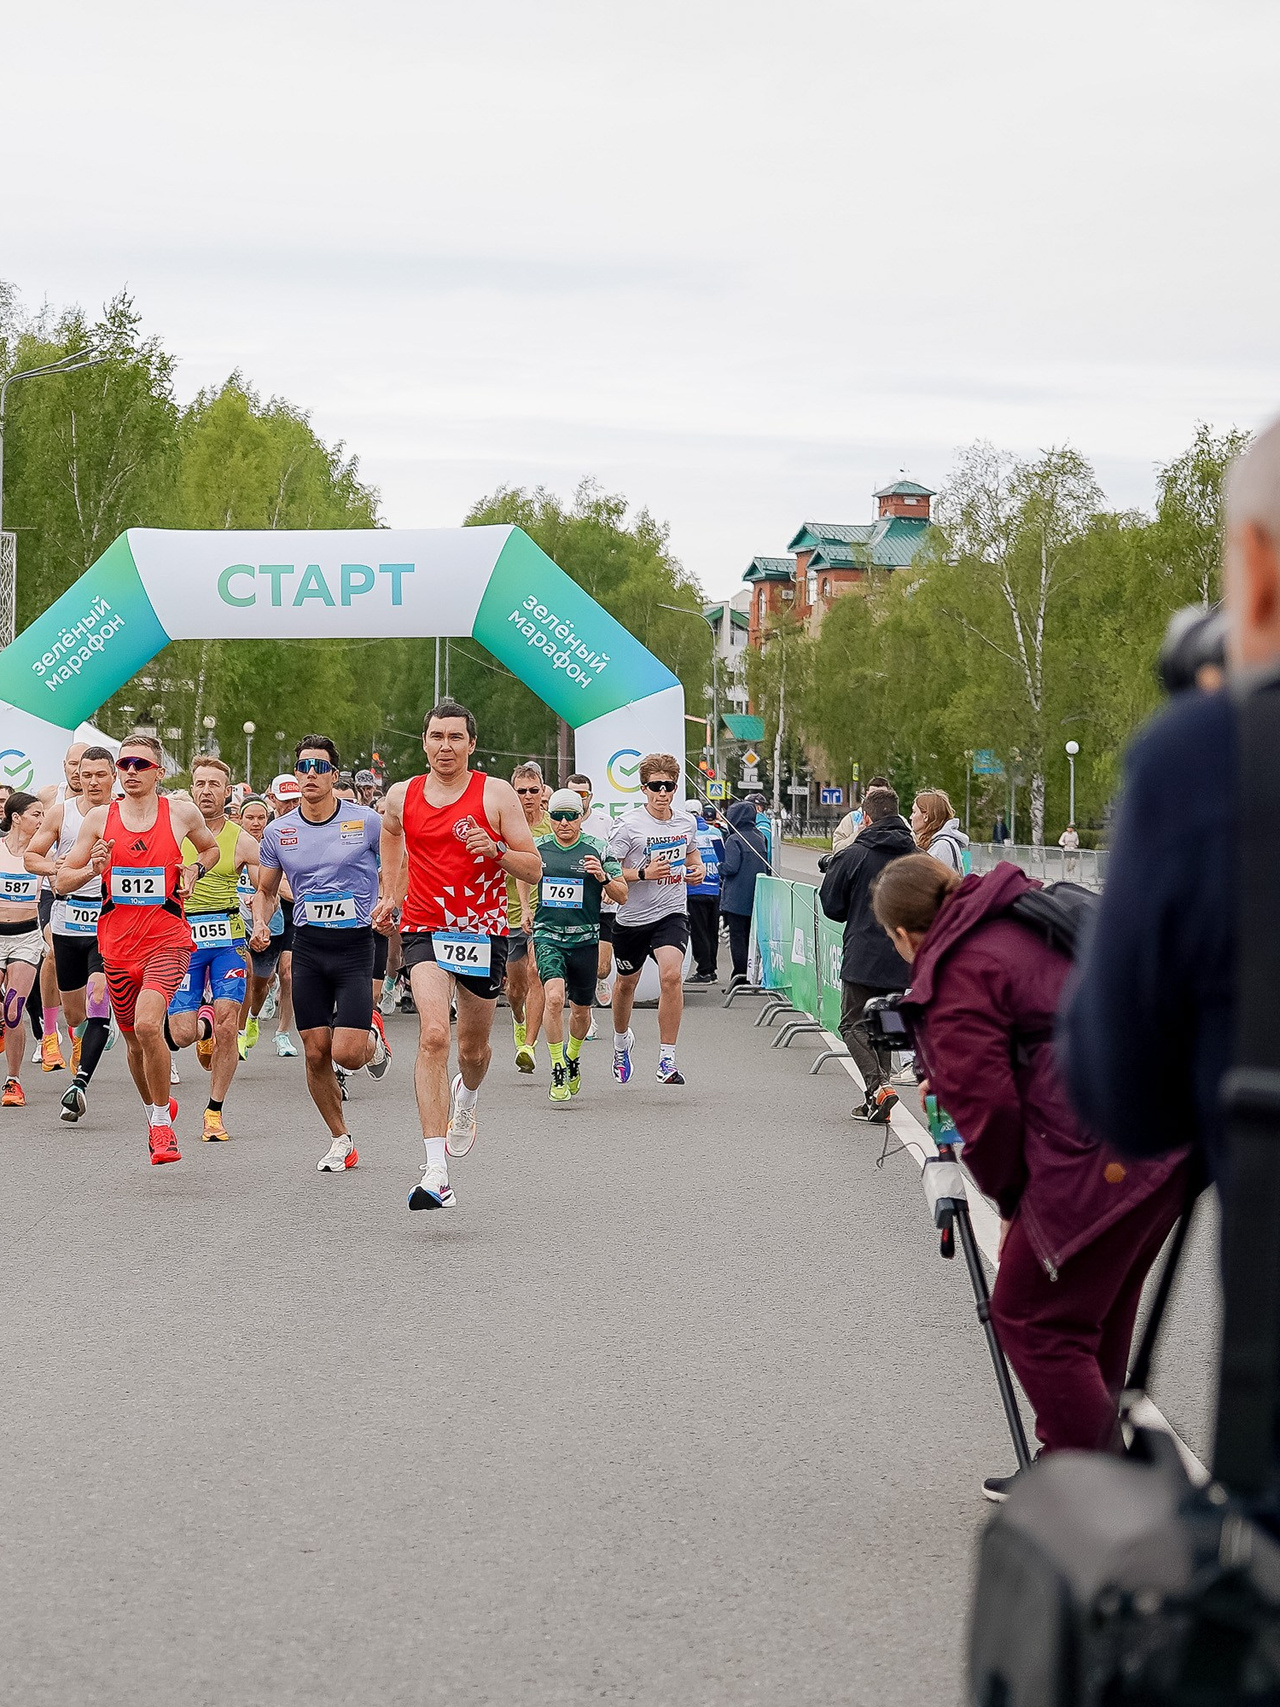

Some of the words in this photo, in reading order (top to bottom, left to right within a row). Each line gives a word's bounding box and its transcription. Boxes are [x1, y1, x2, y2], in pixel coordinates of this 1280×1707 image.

[217, 563, 416, 608] СТАРТ
[31, 595, 112, 677] зелёный
[522, 594, 611, 674] зелёный
[44, 613, 126, 692] марафон
[507, 609, 593, 689] марафон
[658, 848, 680, 861] 573
[5, 882, 30, 894] 587
[121, 879, 155, 893] 812
[550, 886, 575, 899] 769
[73, 909, 99, 922] 702
[313, 903, 346, 919] 774
[191, 924, 227, 939] 1055
[443, 944, 479, 963] 784
